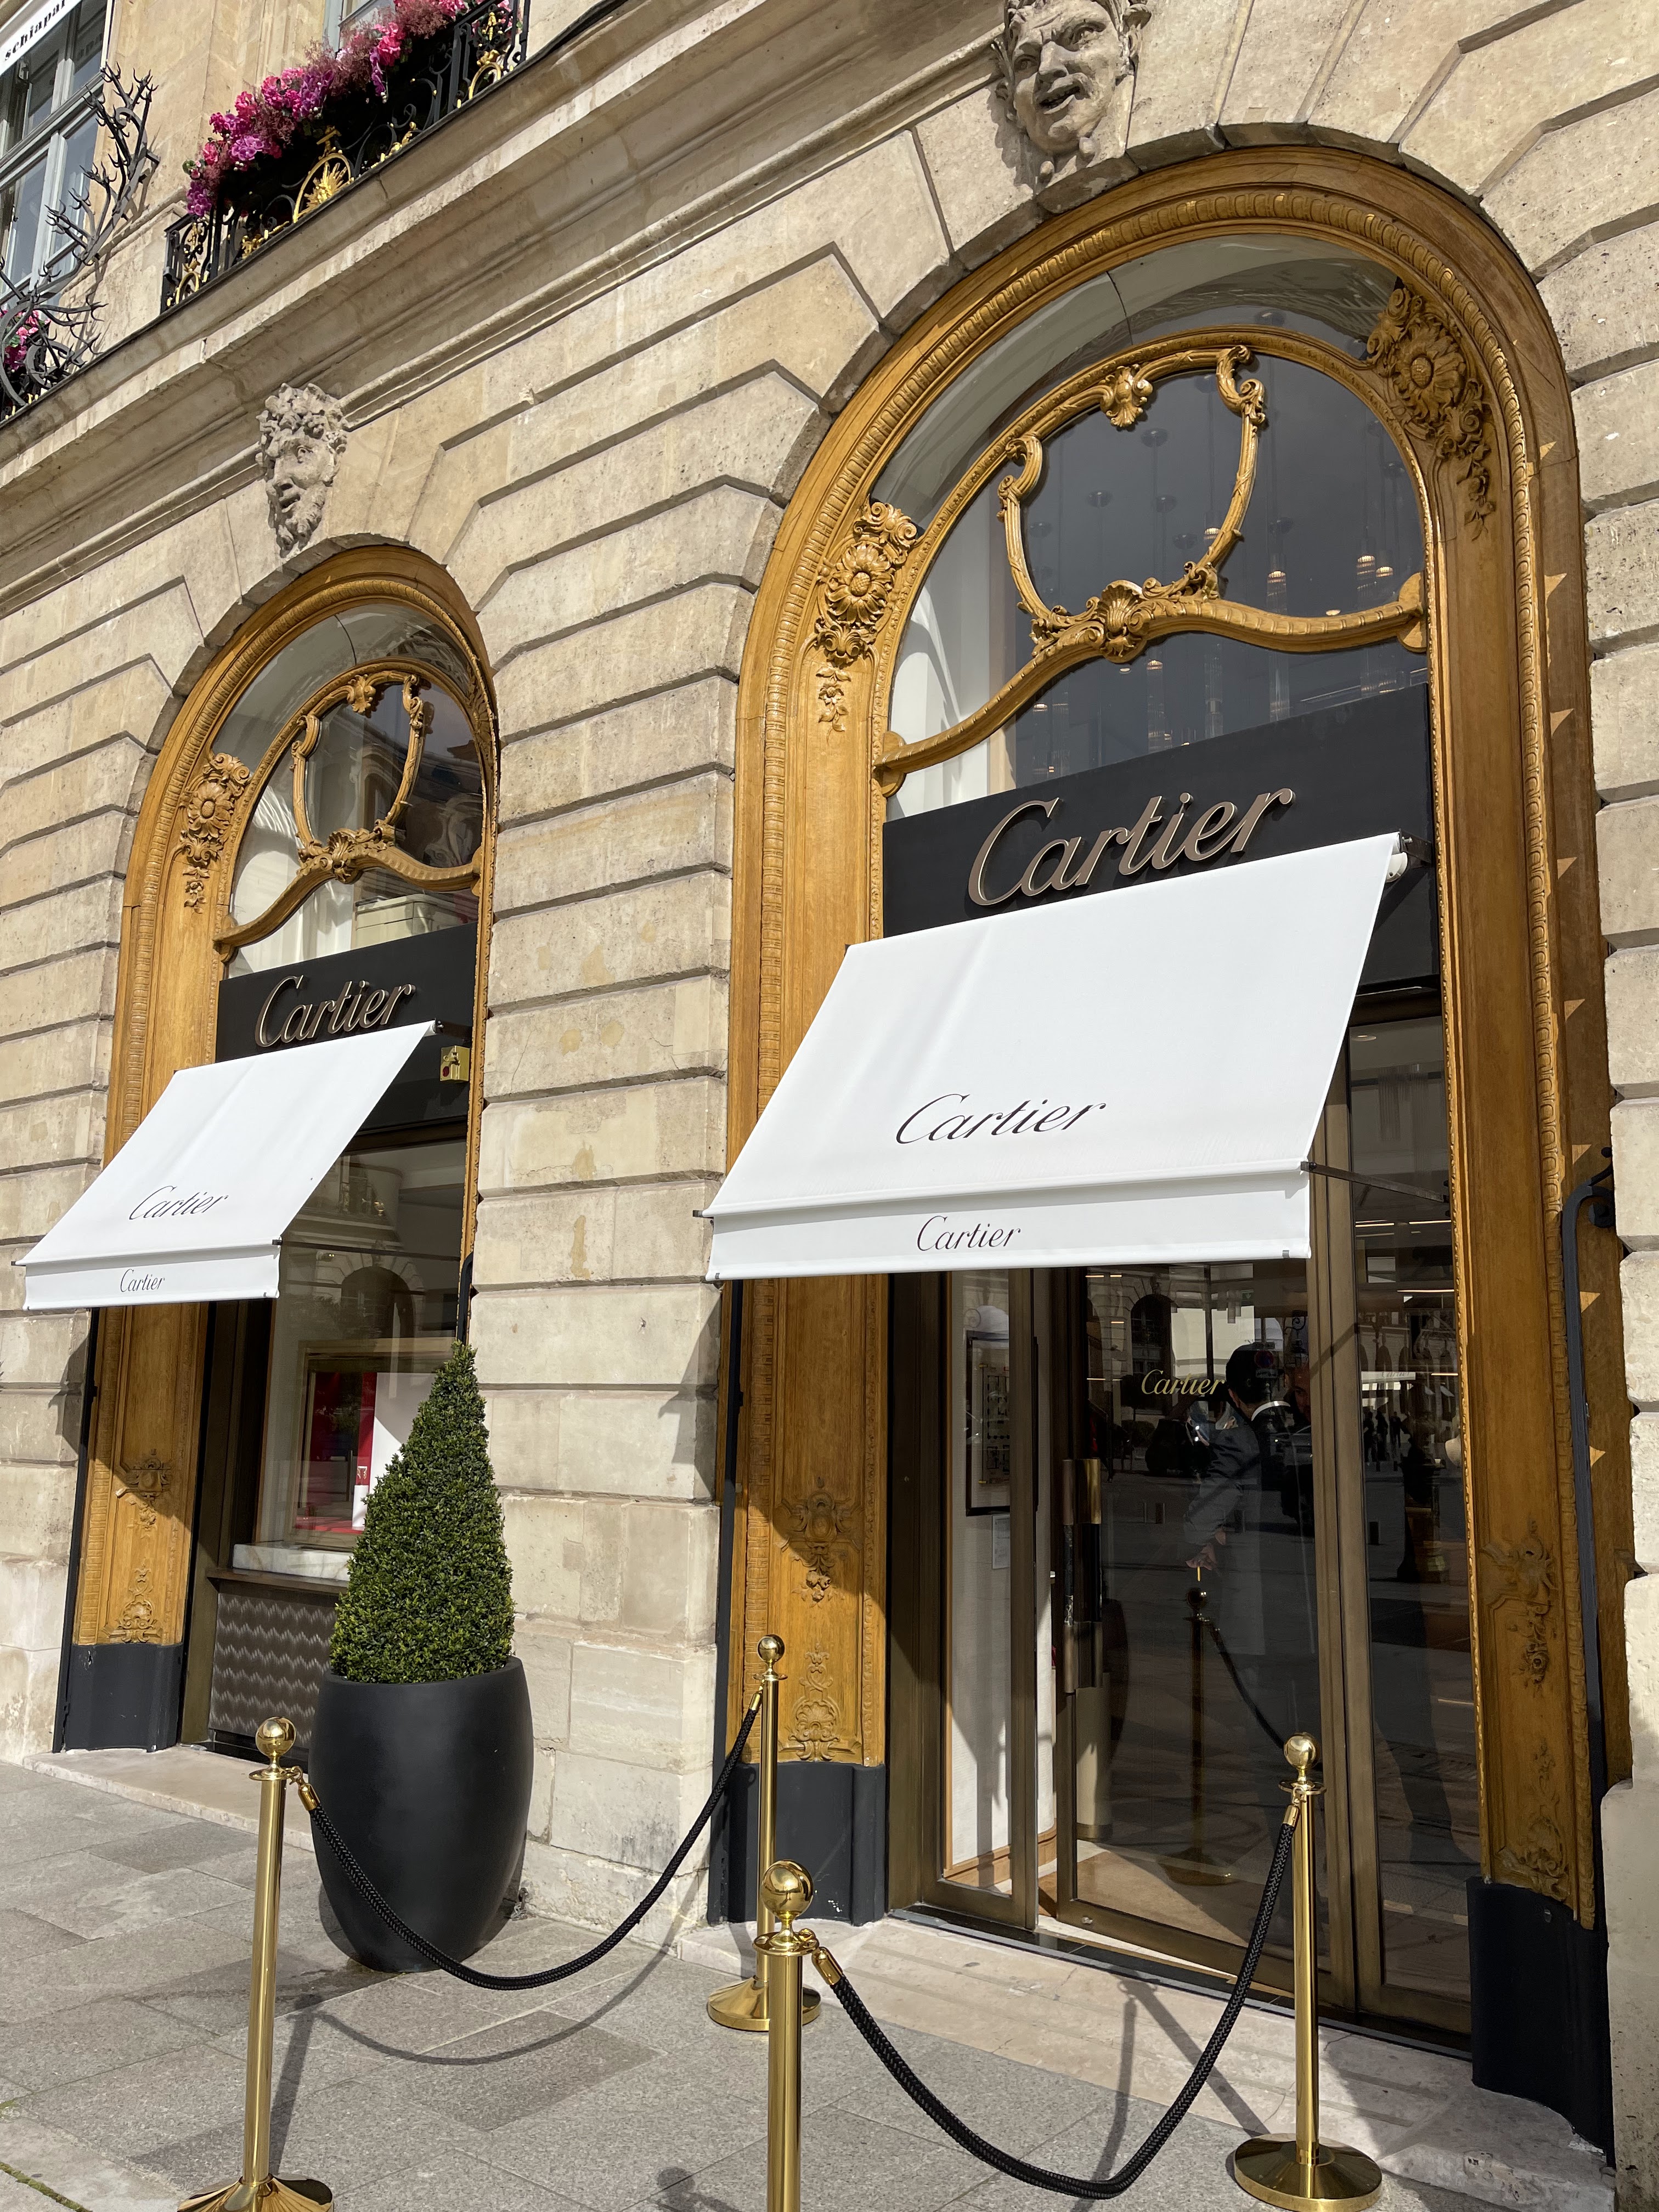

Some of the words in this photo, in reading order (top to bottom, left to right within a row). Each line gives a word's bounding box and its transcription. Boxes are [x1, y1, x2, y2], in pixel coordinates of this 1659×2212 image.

[968, 788, 1295, 906] Cartier
[255, 975, 416, 1047] Cartier
[896, 1094, 1106, 1144] Cartier
[129, 1185, 229, 1220] Cartier
[917, 1215, 1021, 1251] Cartier
[120, 1268, 165, 1293] Cartier
[1141, 1369, 1226, 1395] Cartier
